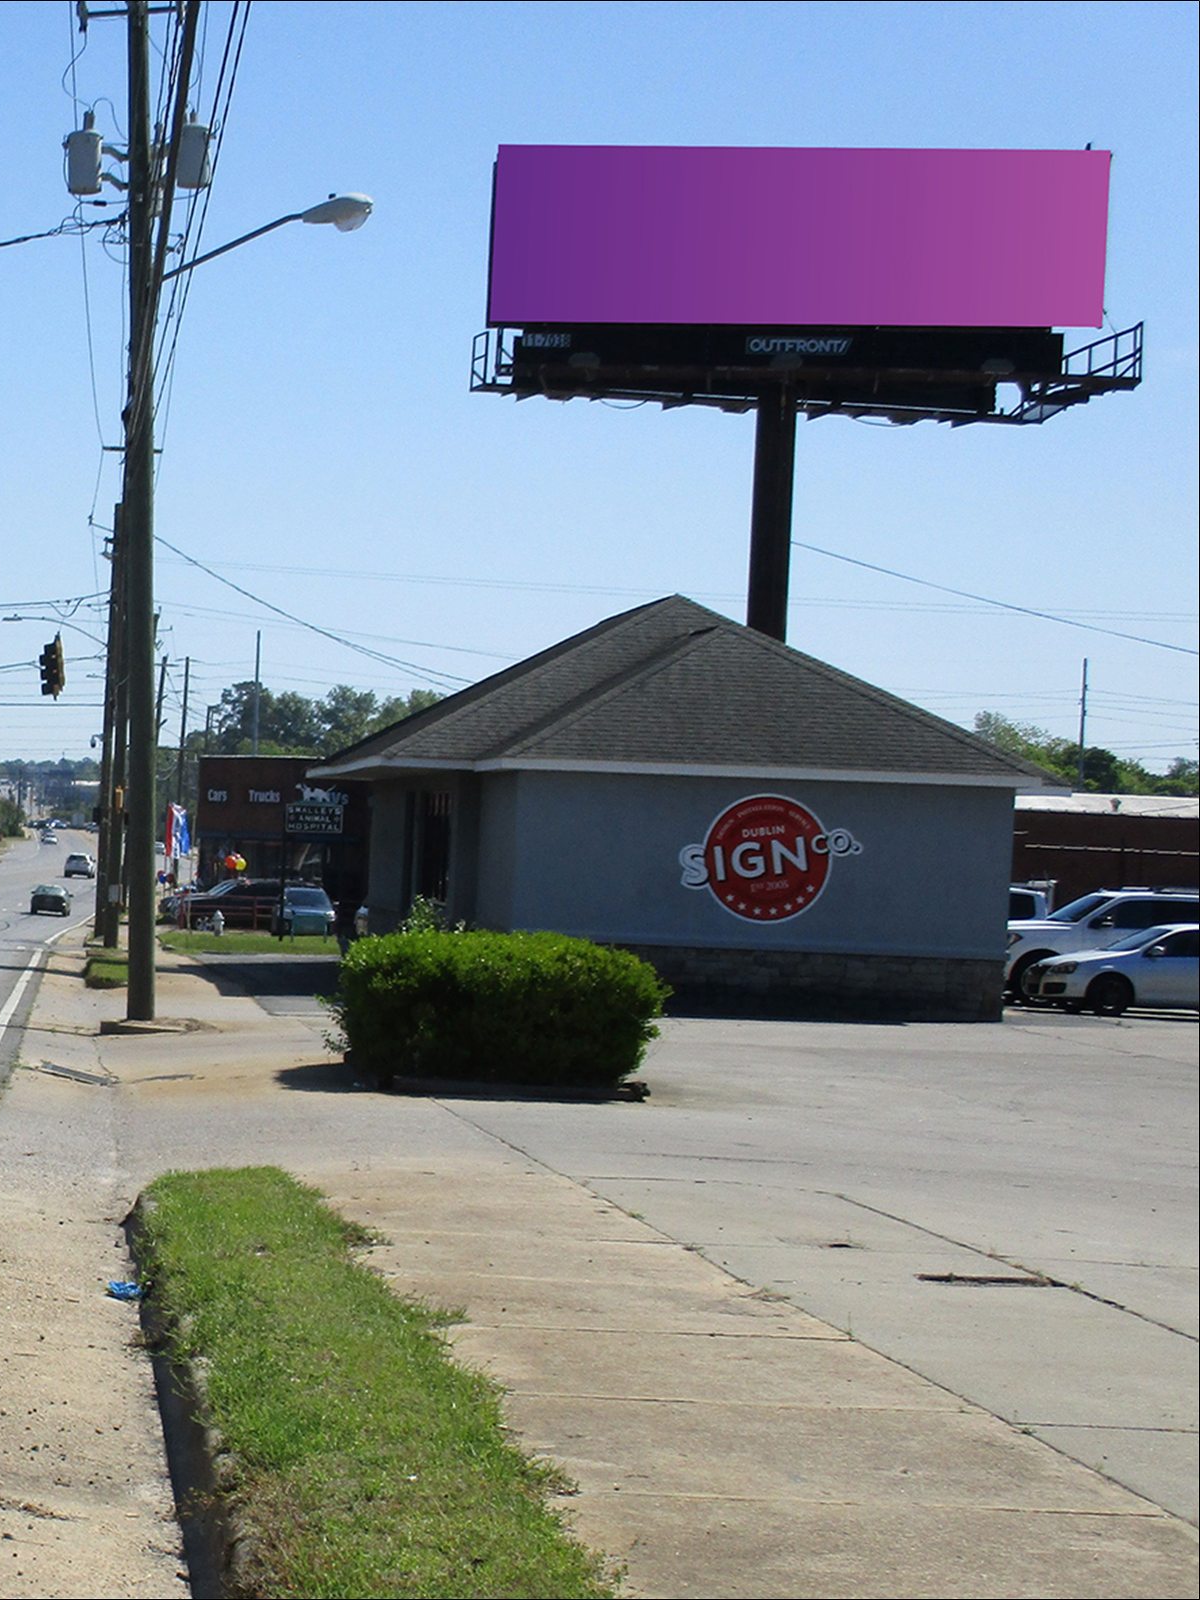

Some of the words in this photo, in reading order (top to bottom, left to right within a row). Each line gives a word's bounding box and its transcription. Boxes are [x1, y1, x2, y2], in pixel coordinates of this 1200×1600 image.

[207, 788, 228, 802] Cars
[249, 789, 280, 802] Trucks
[288, 806, 342, 815] SMALLEYS
[299, 815, 331, 823] ANIMAL
[288, 823, 339, 832] HOSPITAL
[741, 825, 785, 839] DUBLIN
[680, 836, 808, 886] SIGN
